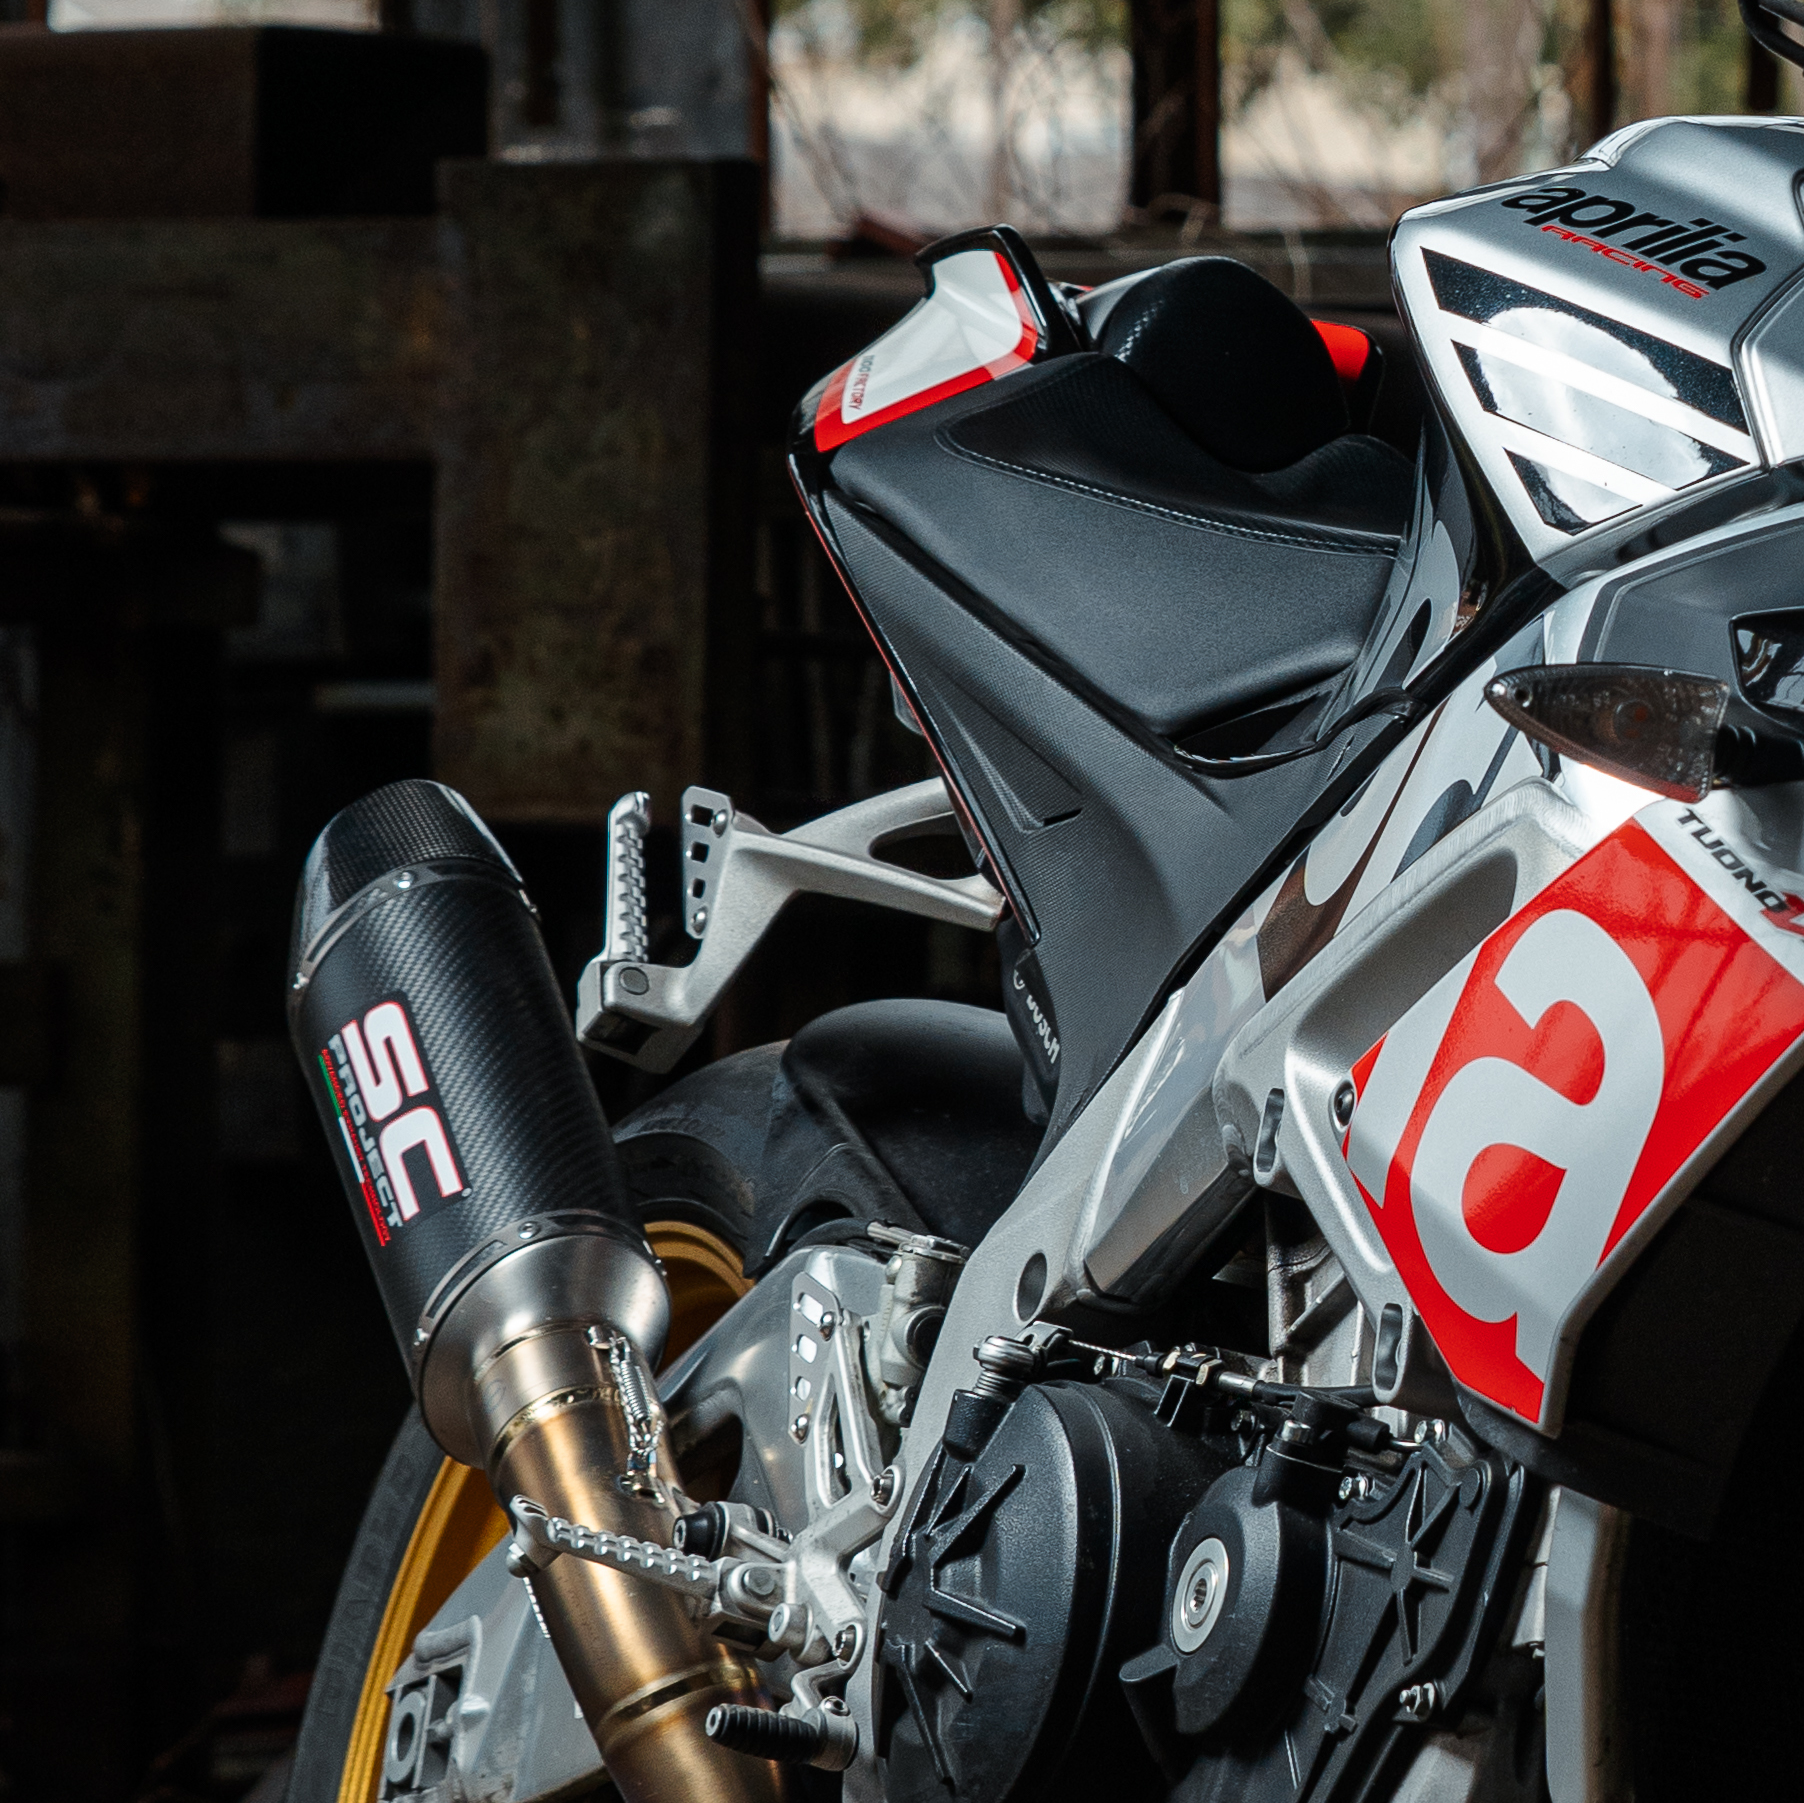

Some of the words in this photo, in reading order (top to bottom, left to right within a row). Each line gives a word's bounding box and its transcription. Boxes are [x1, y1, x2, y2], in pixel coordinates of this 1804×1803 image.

[1501, 185, 1767, 291] aprilia
[1540, 224, 1710, 300] RACING
[1676, 807, 1790, 913] TUONO
[327, 1033, 404, 1228] PROJECT
[340, 999, 464, 1223] SC
